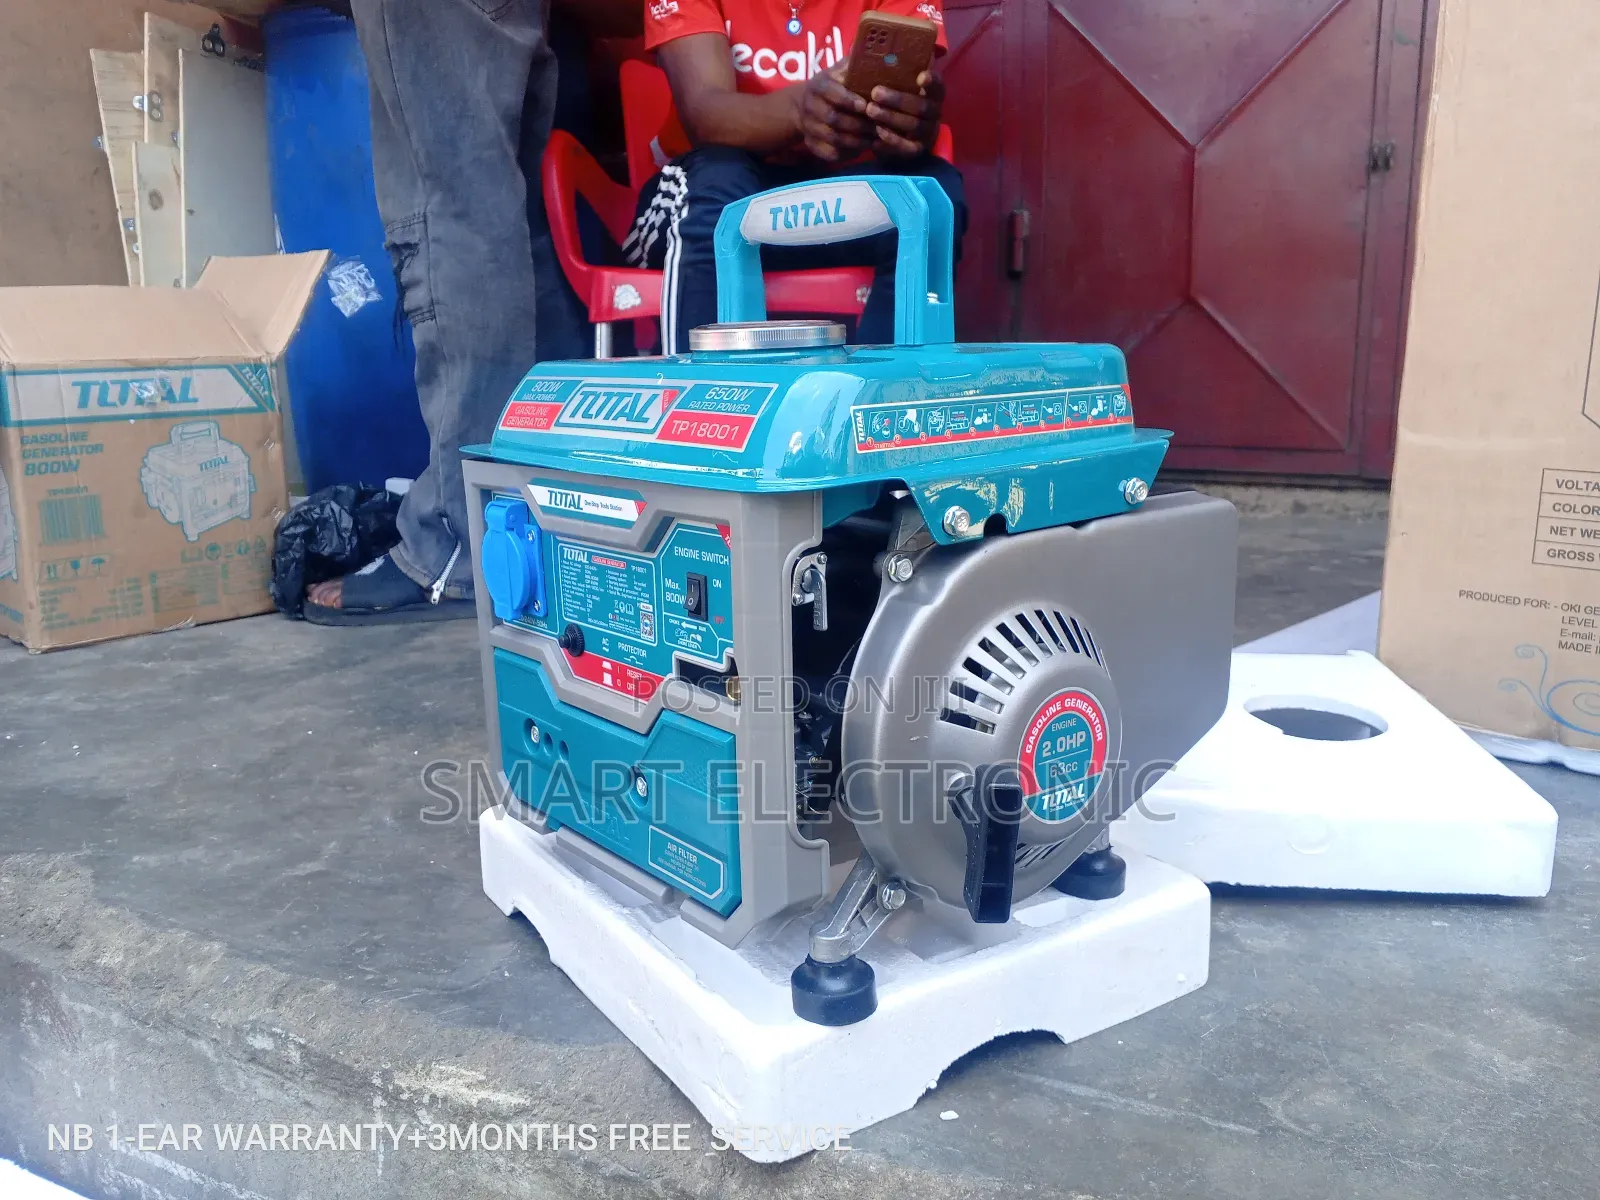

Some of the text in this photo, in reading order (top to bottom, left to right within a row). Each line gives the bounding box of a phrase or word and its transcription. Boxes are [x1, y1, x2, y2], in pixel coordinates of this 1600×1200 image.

[770, 197, 847, 230] TOTAL
[531, 381, 565, 393] 800W
[704, 386, 755, 402] 650W
[514, 405, 549, 416] GASOLINE
[568, 390, 660, 424] TOTAL
[688, 401, 750, 413] RATED POWER
[506, 416, 549, 427] GENERATOR
[671, 419, 741, 441] TP18001
[20, 431, 88, 446] GASOLINE
[22, 443, 104, 459] GENERATOR
[24, 459, 81, 476] 800W
[199, 455, 231, 472] TOTAL
[548, 489, 583, 510] TOTAL
[1549, 525, 1577, 538] NET
[563, 547, 589, 563] TOTAL
[674, 546, 729, 565] ENGINE SWITCH
[1546, 548, 1595, 562] GROSS
[664, 578, 681, 590] Max.
[712, 578, 722, 589] ON
[665, 592, 686, 604] 800W
[1458, 589, 1521, 606] PRODUCED
[1523, 598, 1551, 610] FOR:
[1560, 602, 1581, 613] OKI
[1561, 616, 1598, 629] LEVEL
[1560, 628, 1596, 641] E-mail:
[617, 642, 647, 658] PROTECTOR
[1558, 640, 1592, 653] MADE
[626, 669, 642, 679] RESET
[1026, 698, 1103, 754] GASOLINE GENERATOR
[1051, 718, 1077, 732] ENGINE
[1042, 731, 1087, 757] 2.0HP
[1050, 761, 1078, 778] 63cc
[1041, 783, 1085, 810] TOTAL
[667, 842, 677, 853] AIR
[678, 847, 698, 864] FILTER
